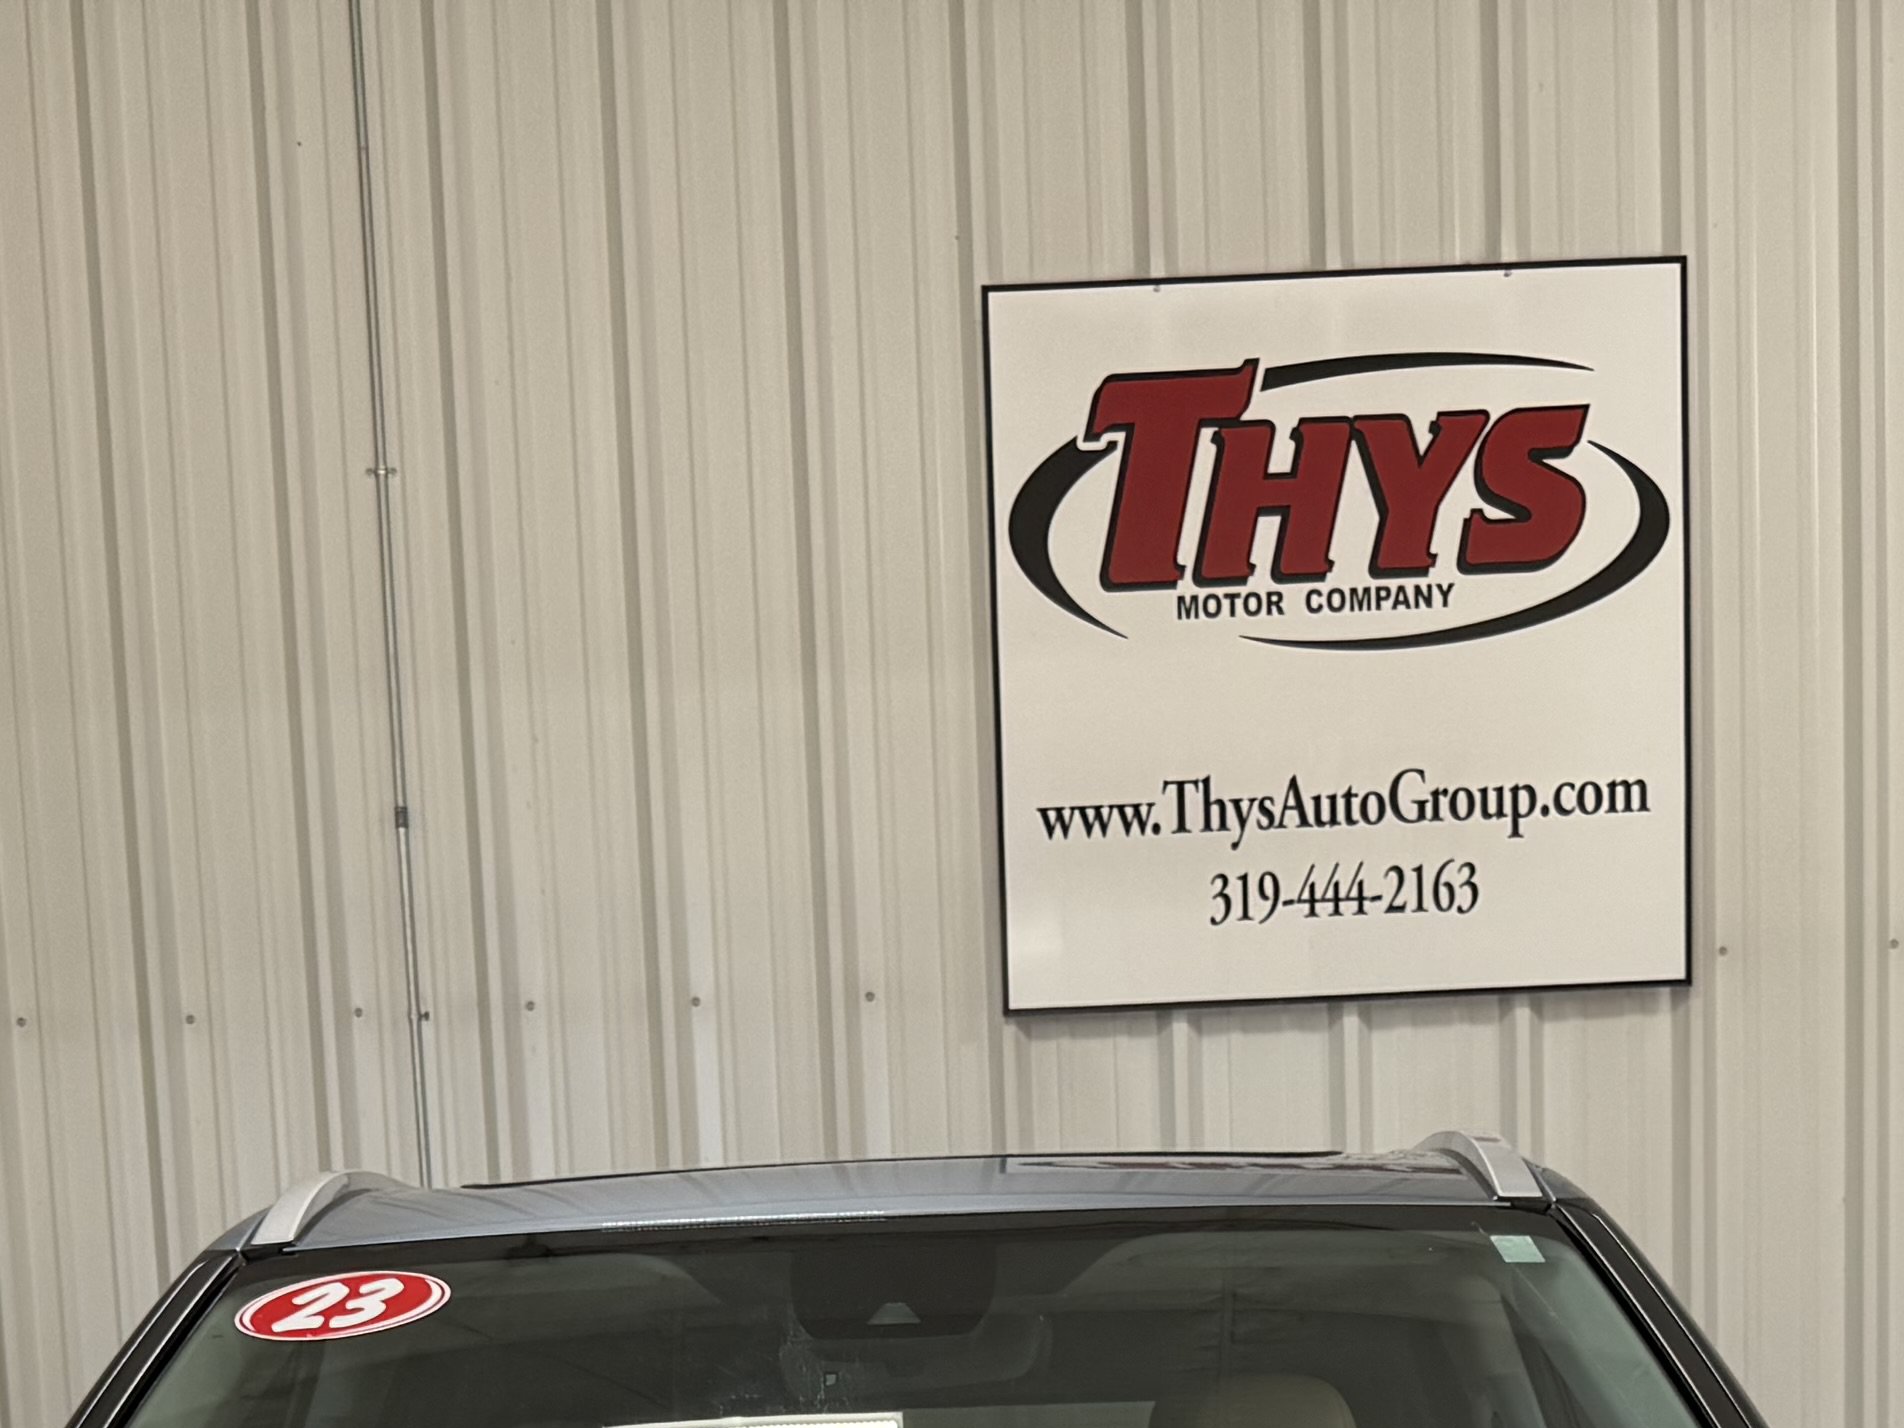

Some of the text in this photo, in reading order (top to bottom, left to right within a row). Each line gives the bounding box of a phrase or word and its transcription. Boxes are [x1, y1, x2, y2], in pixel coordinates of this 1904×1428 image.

[1086, 358, 1590, 592] THYS
[1177, 582, 1456, 620] MOTOR COMPANY
[1036, 769, 1652, 851] www.ThysAutoGroup.com
[1209, 860, 1480, 926] 319-444-2163
[270, 1278, 405, 1333] 23
